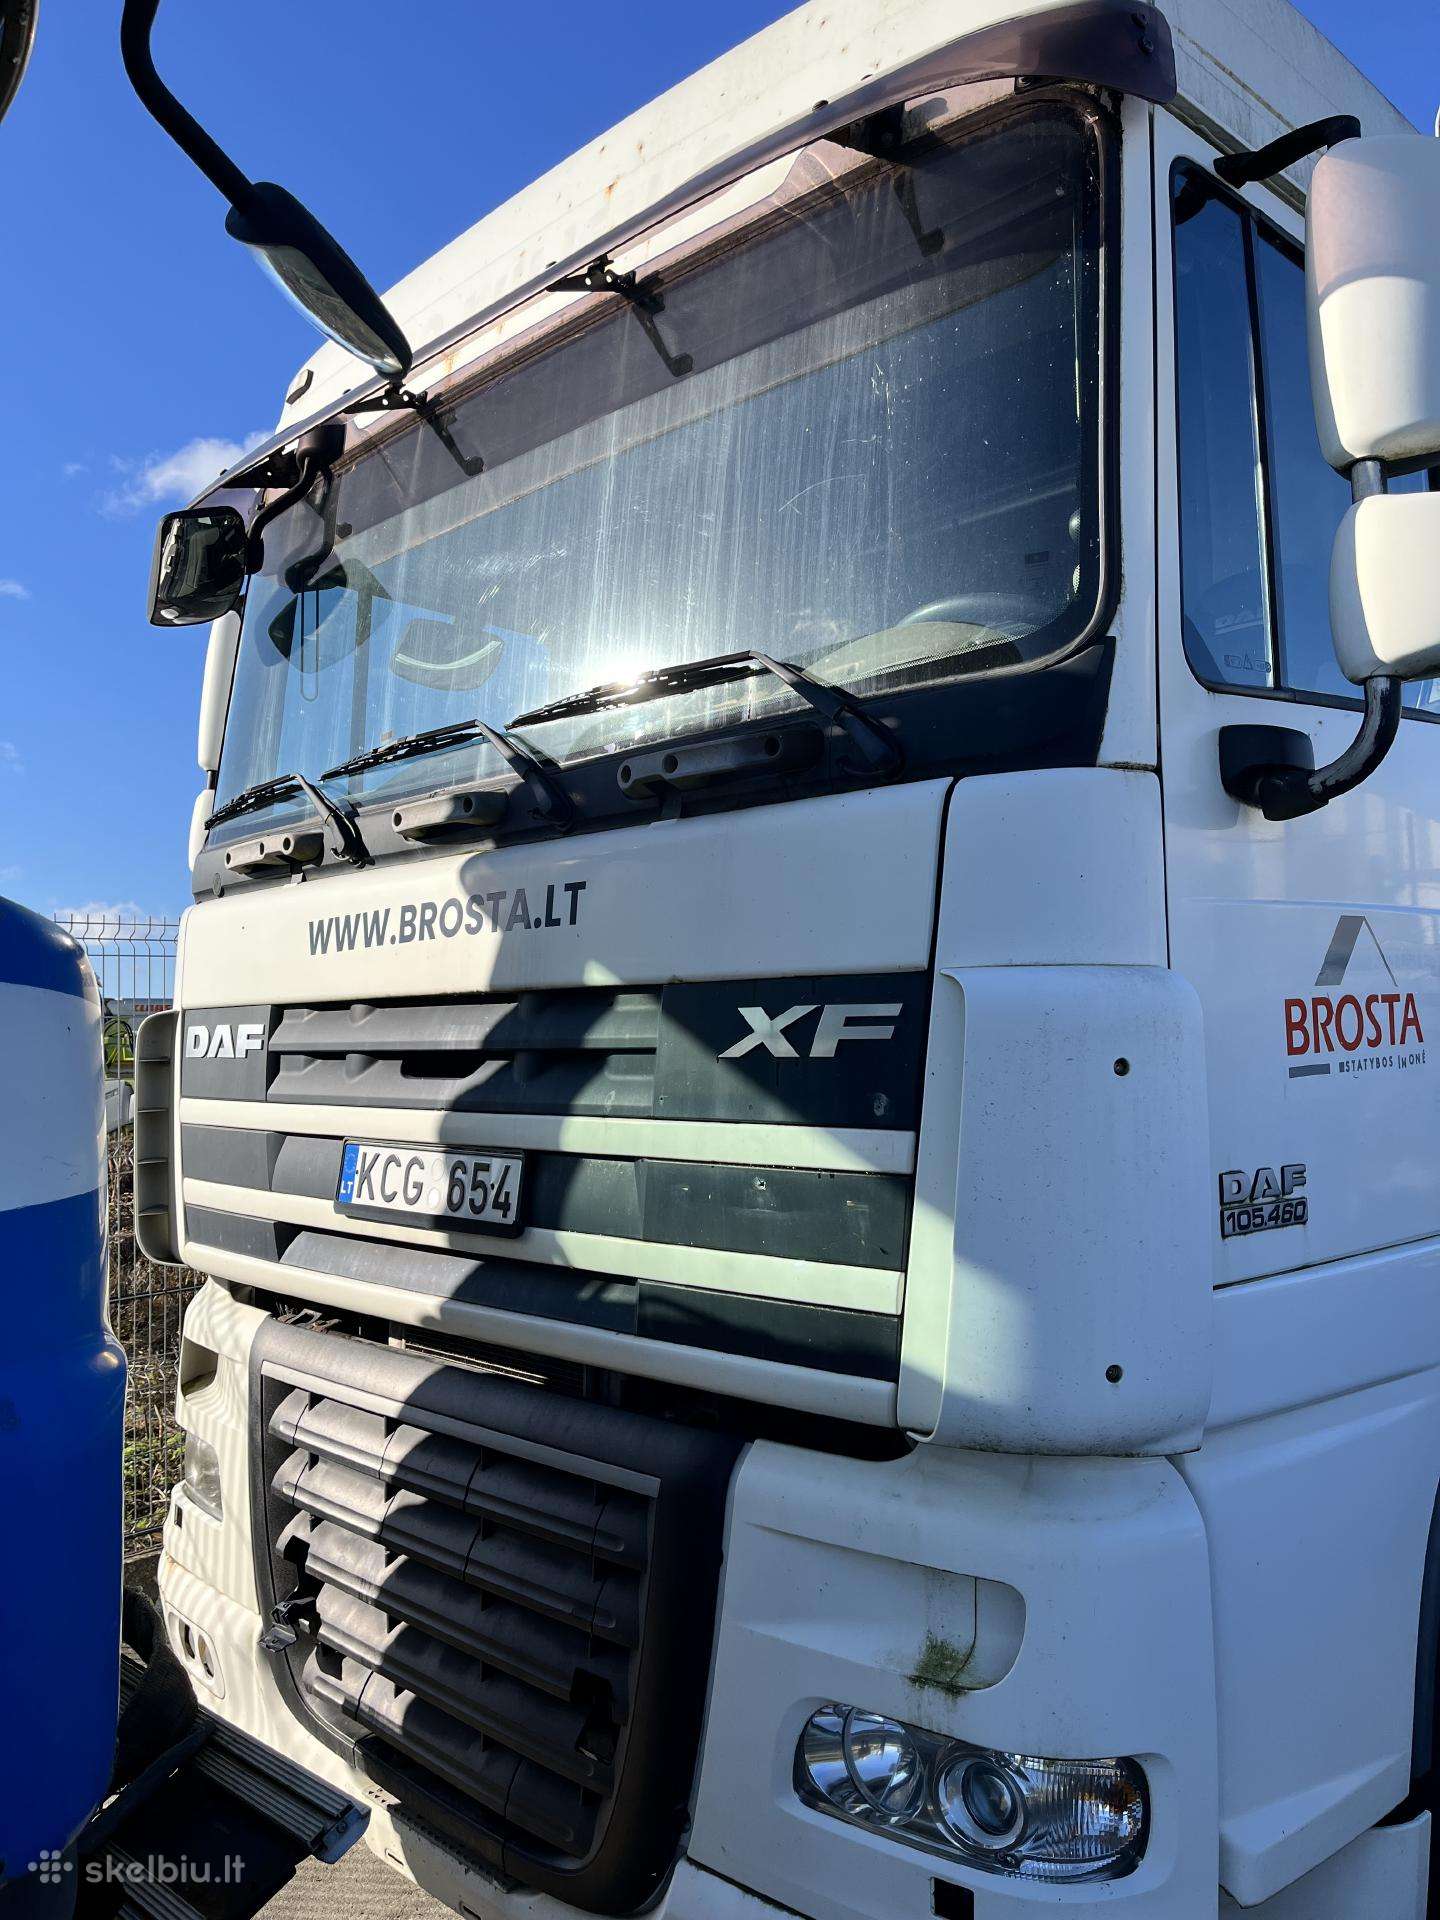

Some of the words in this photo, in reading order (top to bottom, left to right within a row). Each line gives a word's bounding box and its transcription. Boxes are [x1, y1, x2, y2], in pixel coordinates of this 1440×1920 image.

[308, 881, 587, 956] WWW.BROSTA.LT
[185, 1023, 266, 1059] DAF
[717, 1002, 904, 1058] XF
[1284, 992, 1424, 1057] BROSTA
[1345, 1055, 1394, 1073] STATYBOS
[341, 1180, 354, 1195] LT
[356, 1151, 425, 1206] KCG
[446, 1159, 512, 1219] 654
[1219, 1163, 1307, 1206] DAF
[1226, 1200, 1307, 1233] 105.460
